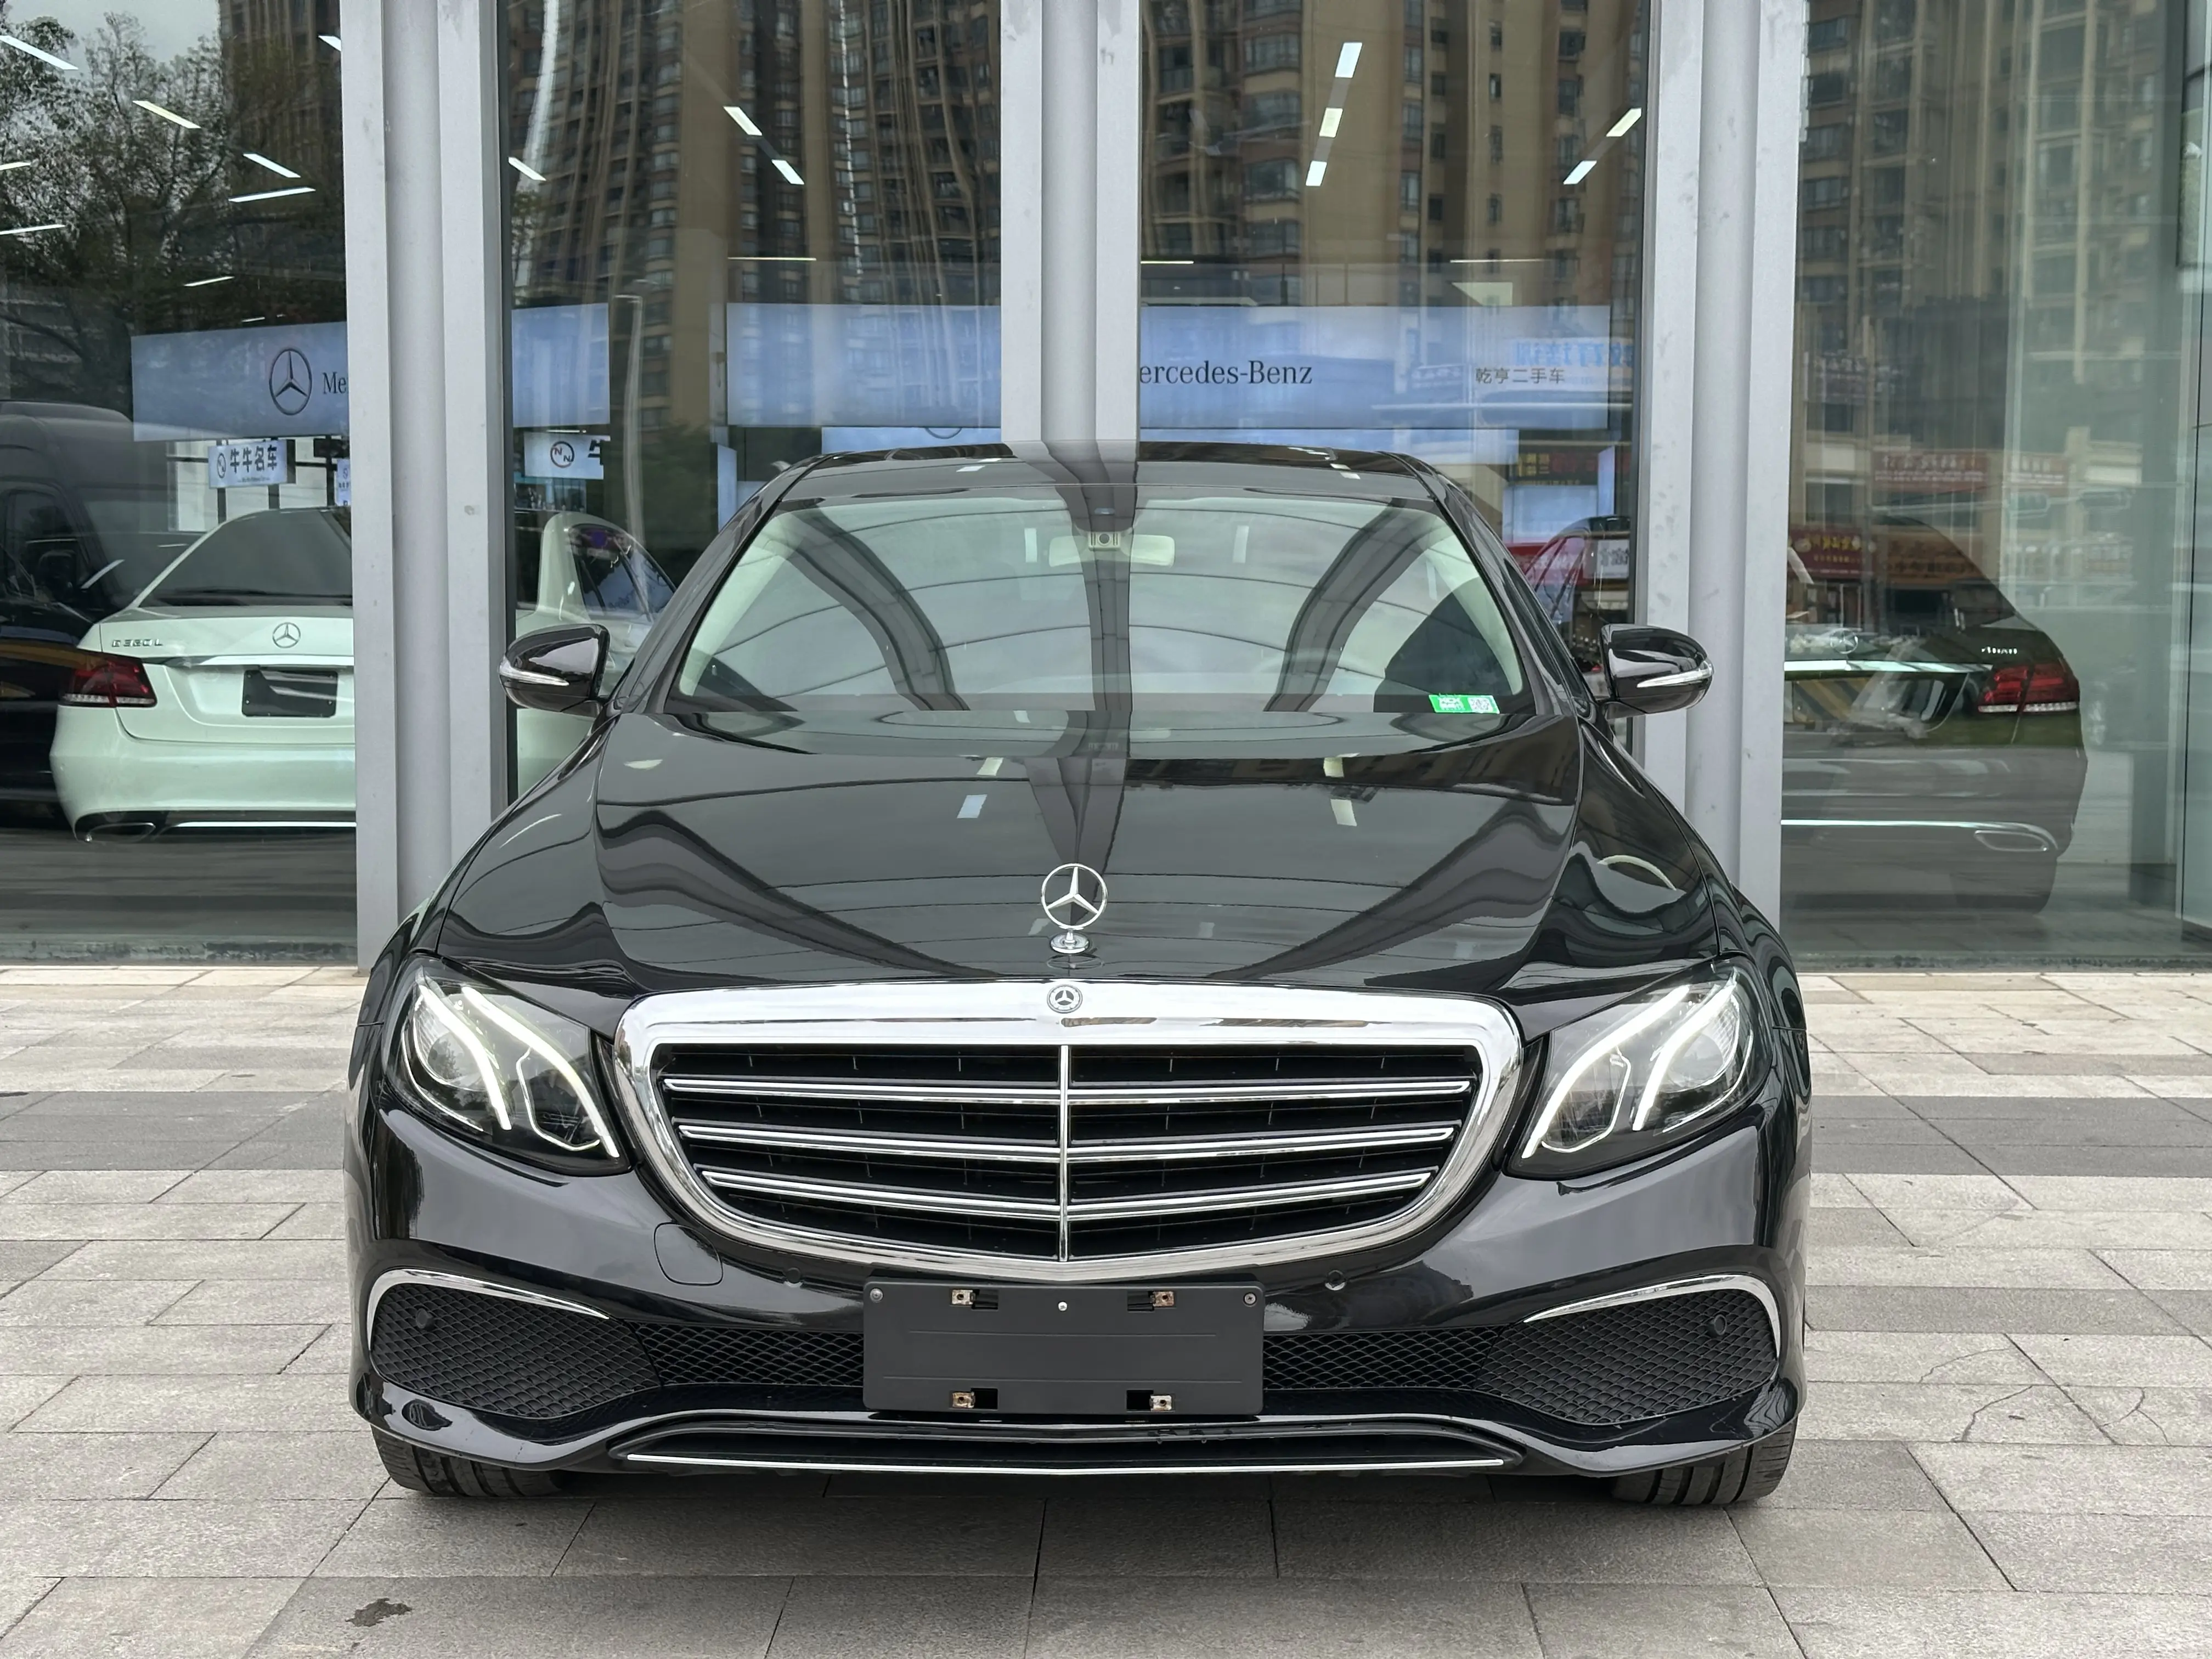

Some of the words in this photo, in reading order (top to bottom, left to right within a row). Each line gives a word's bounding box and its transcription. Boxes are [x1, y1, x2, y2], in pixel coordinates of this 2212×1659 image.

[322, 371, 348, 394] Me
[1139, 360, 1313, 384] ercedes-Benz
[1475, 367, 1565, 384] 乾亨二手车
[230, 444, 278, 474] 牛牛名车
